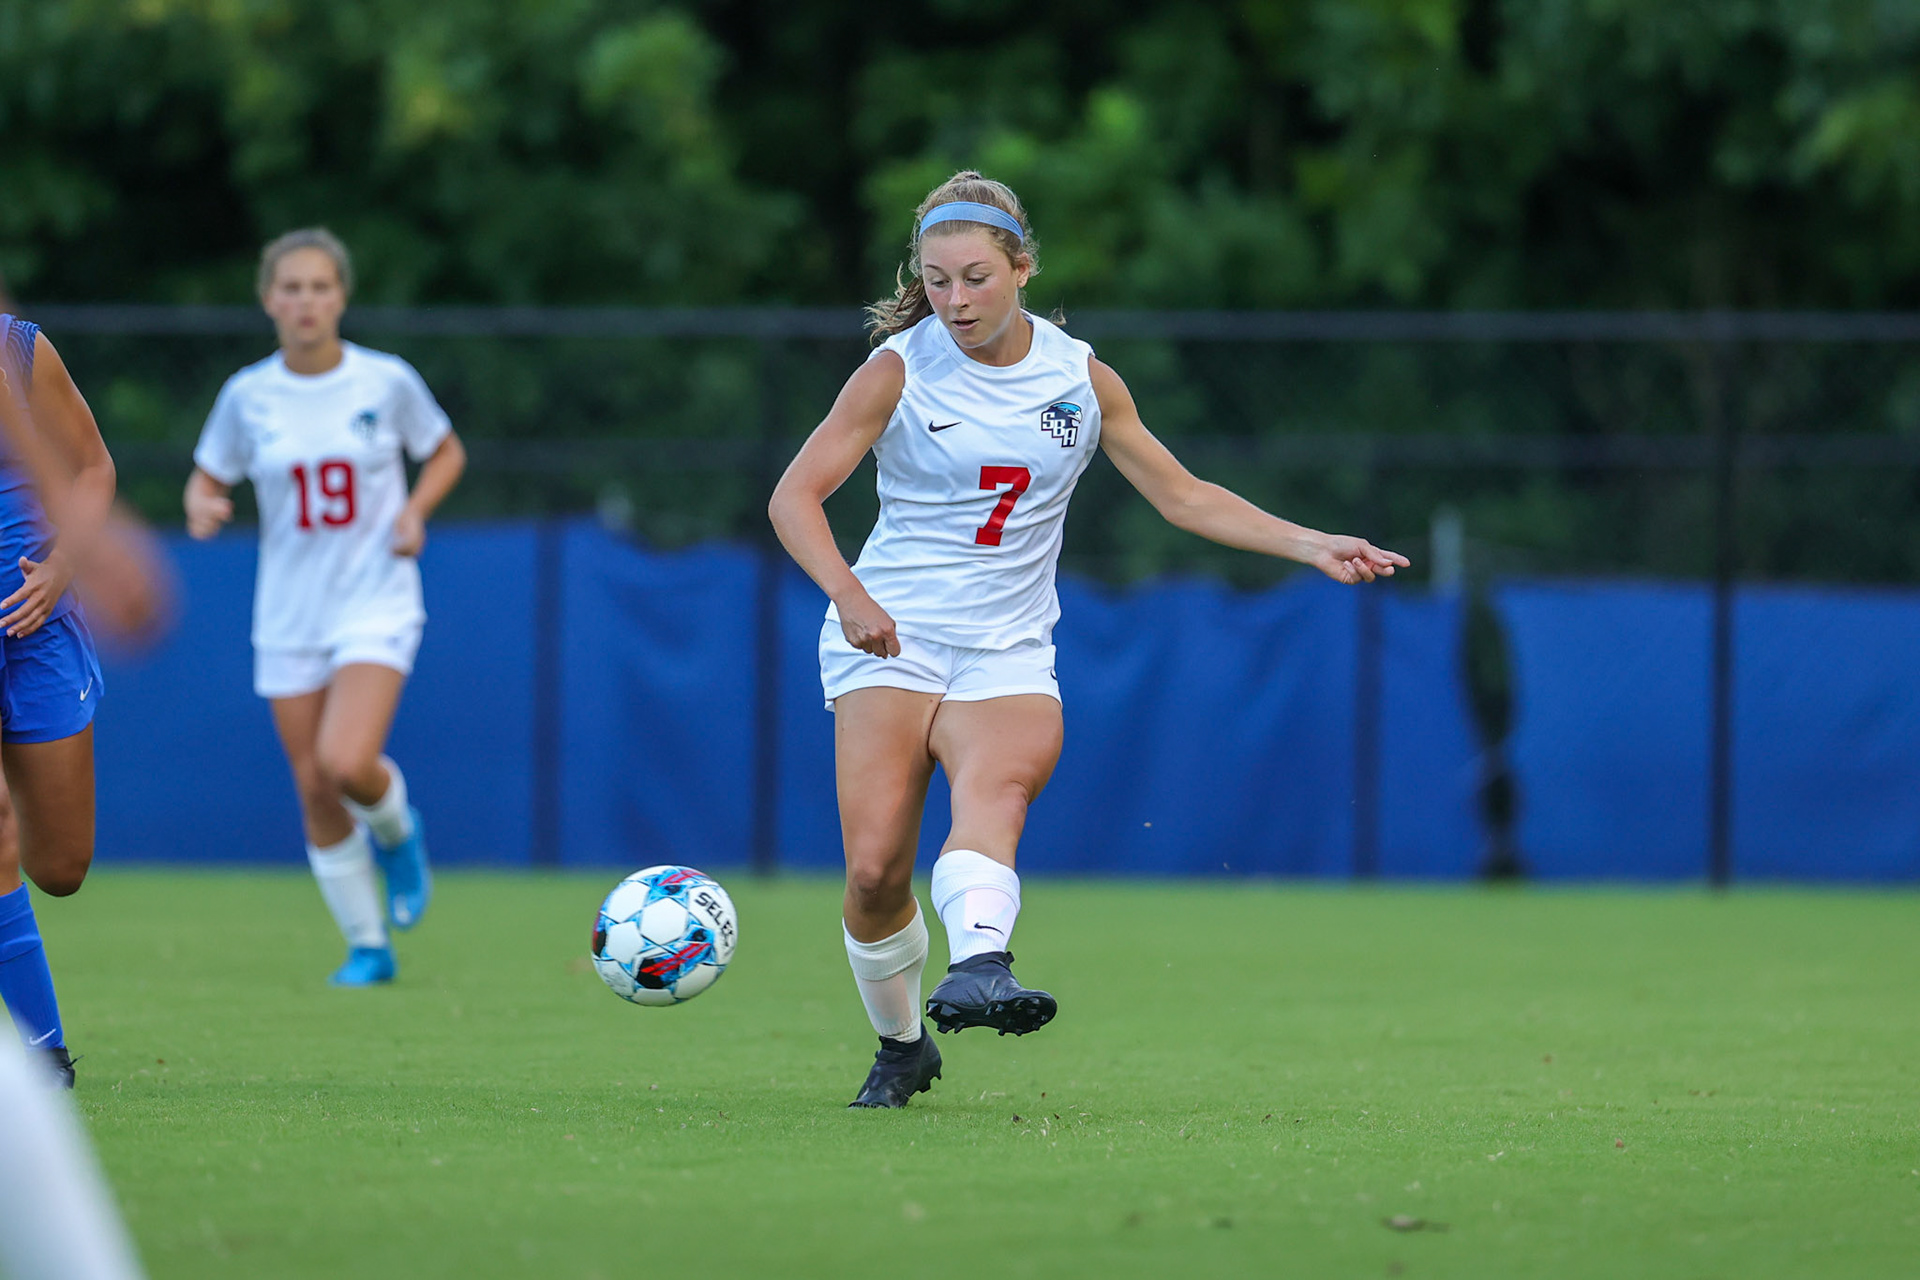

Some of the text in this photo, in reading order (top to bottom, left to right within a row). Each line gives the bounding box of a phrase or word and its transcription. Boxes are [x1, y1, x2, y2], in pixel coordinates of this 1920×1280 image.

[1042, 411, 1076, 446] SBA
[290, 459, 356, 530] 19
[975, 465, 1031, 546] 7
